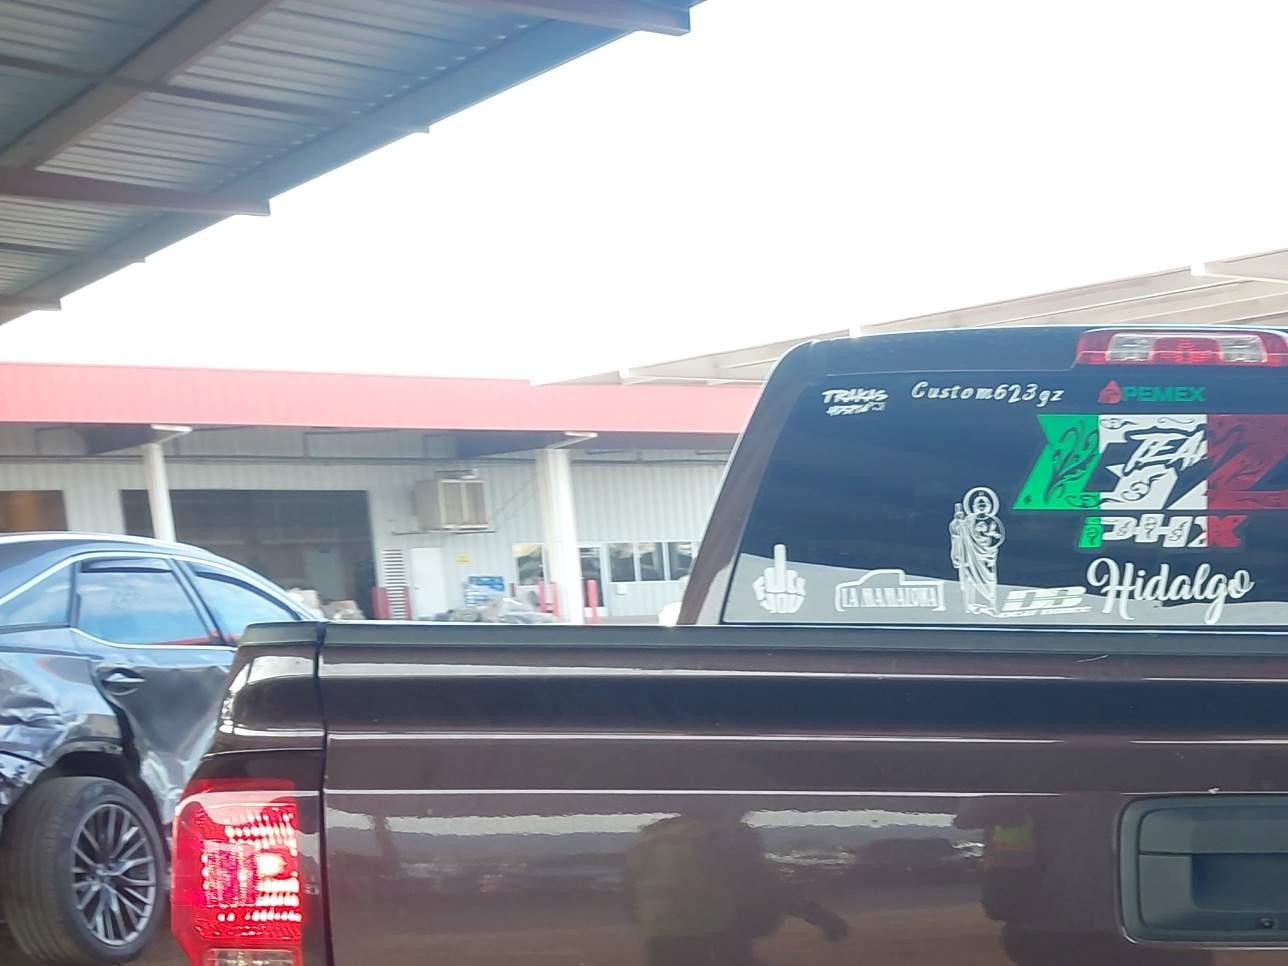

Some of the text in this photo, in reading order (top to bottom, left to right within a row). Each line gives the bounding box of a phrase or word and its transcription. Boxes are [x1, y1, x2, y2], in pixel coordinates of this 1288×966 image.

[911, 380, 1065, 408] Custom623gz
[1122, 385, 1206, 402] PEMEX
[1077, 513, 1249, 548] PHX
[1086, 557, 1255, 625] Hidalgo
